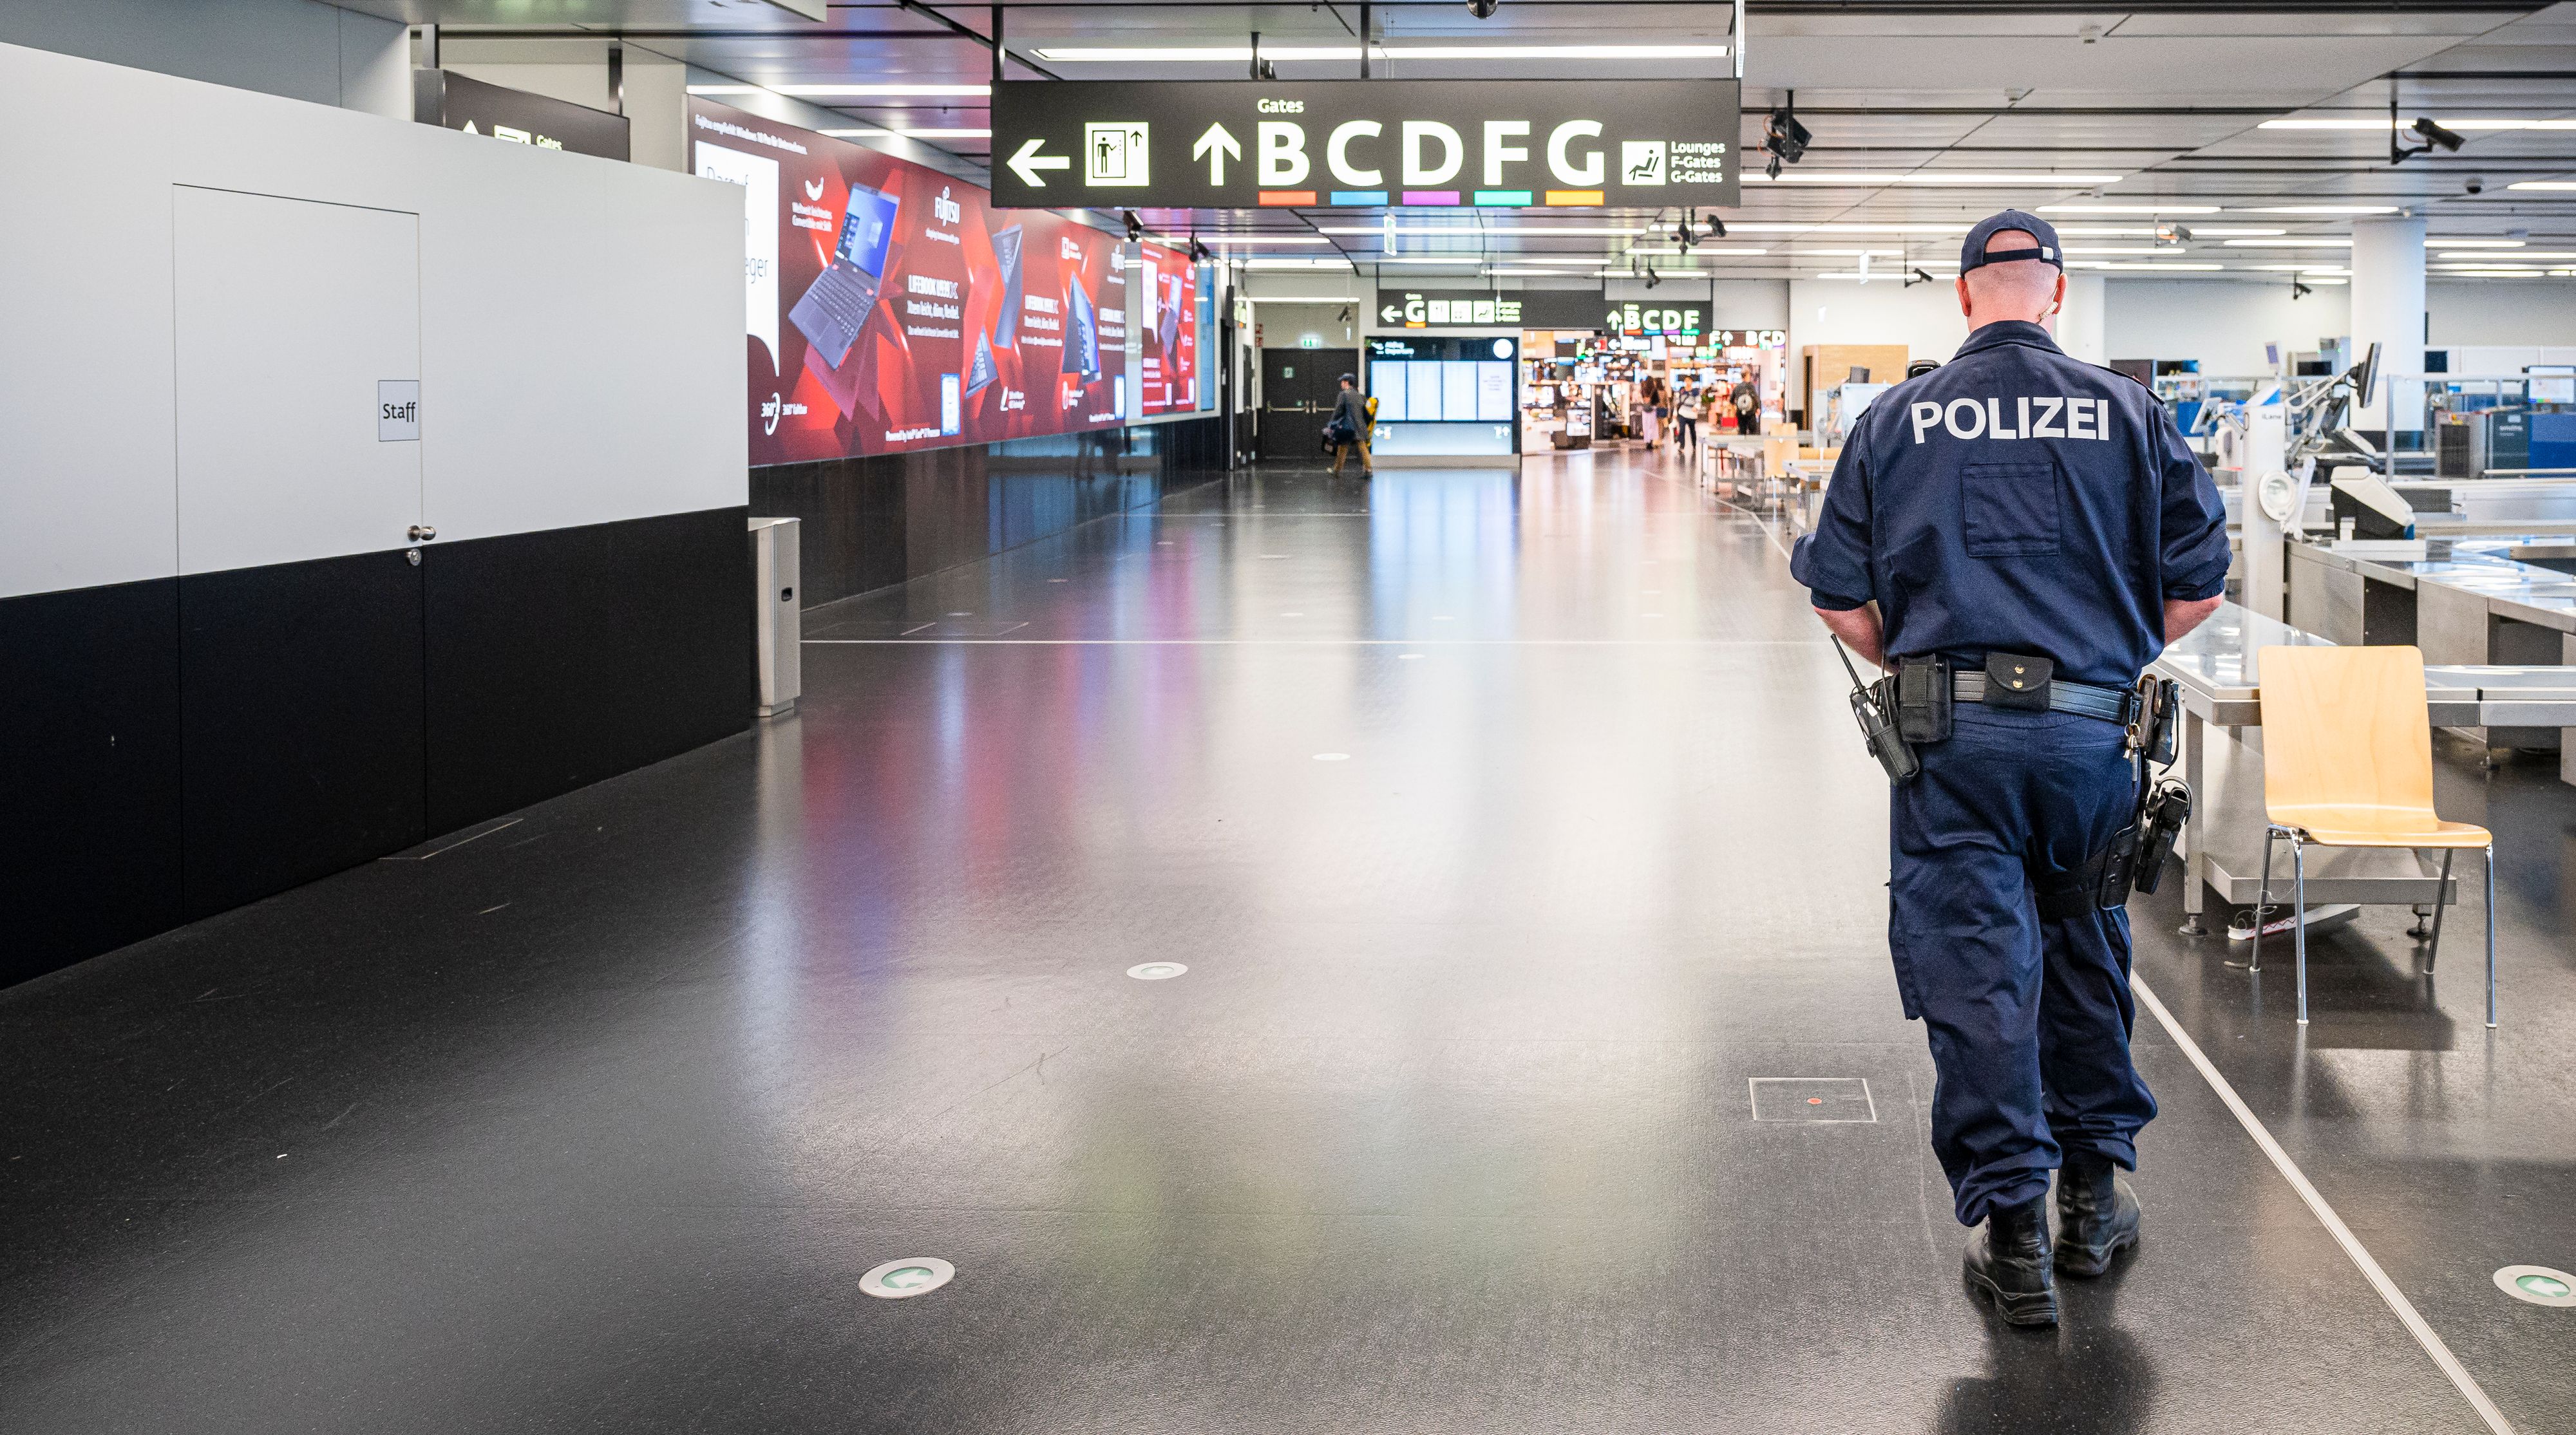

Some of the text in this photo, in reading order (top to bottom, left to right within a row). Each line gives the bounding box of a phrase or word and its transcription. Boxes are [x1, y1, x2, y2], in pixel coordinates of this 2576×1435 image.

[1257, 98, 1305, 114] Gates
[1258, 120, 1605, 187] B C D F G
[1671, 141, 1726, 156] Lounges
[1671, 156, 1721, 169] F-Gates
[1671, 170, 1723, 183] G-Gates
[1405, 300, 1426, 323] G
[1624, 310, 1700, 330] B C D F
[383, 402, 417, 423] Staff
[1911, 397, 2109, 444] POLIZEI
